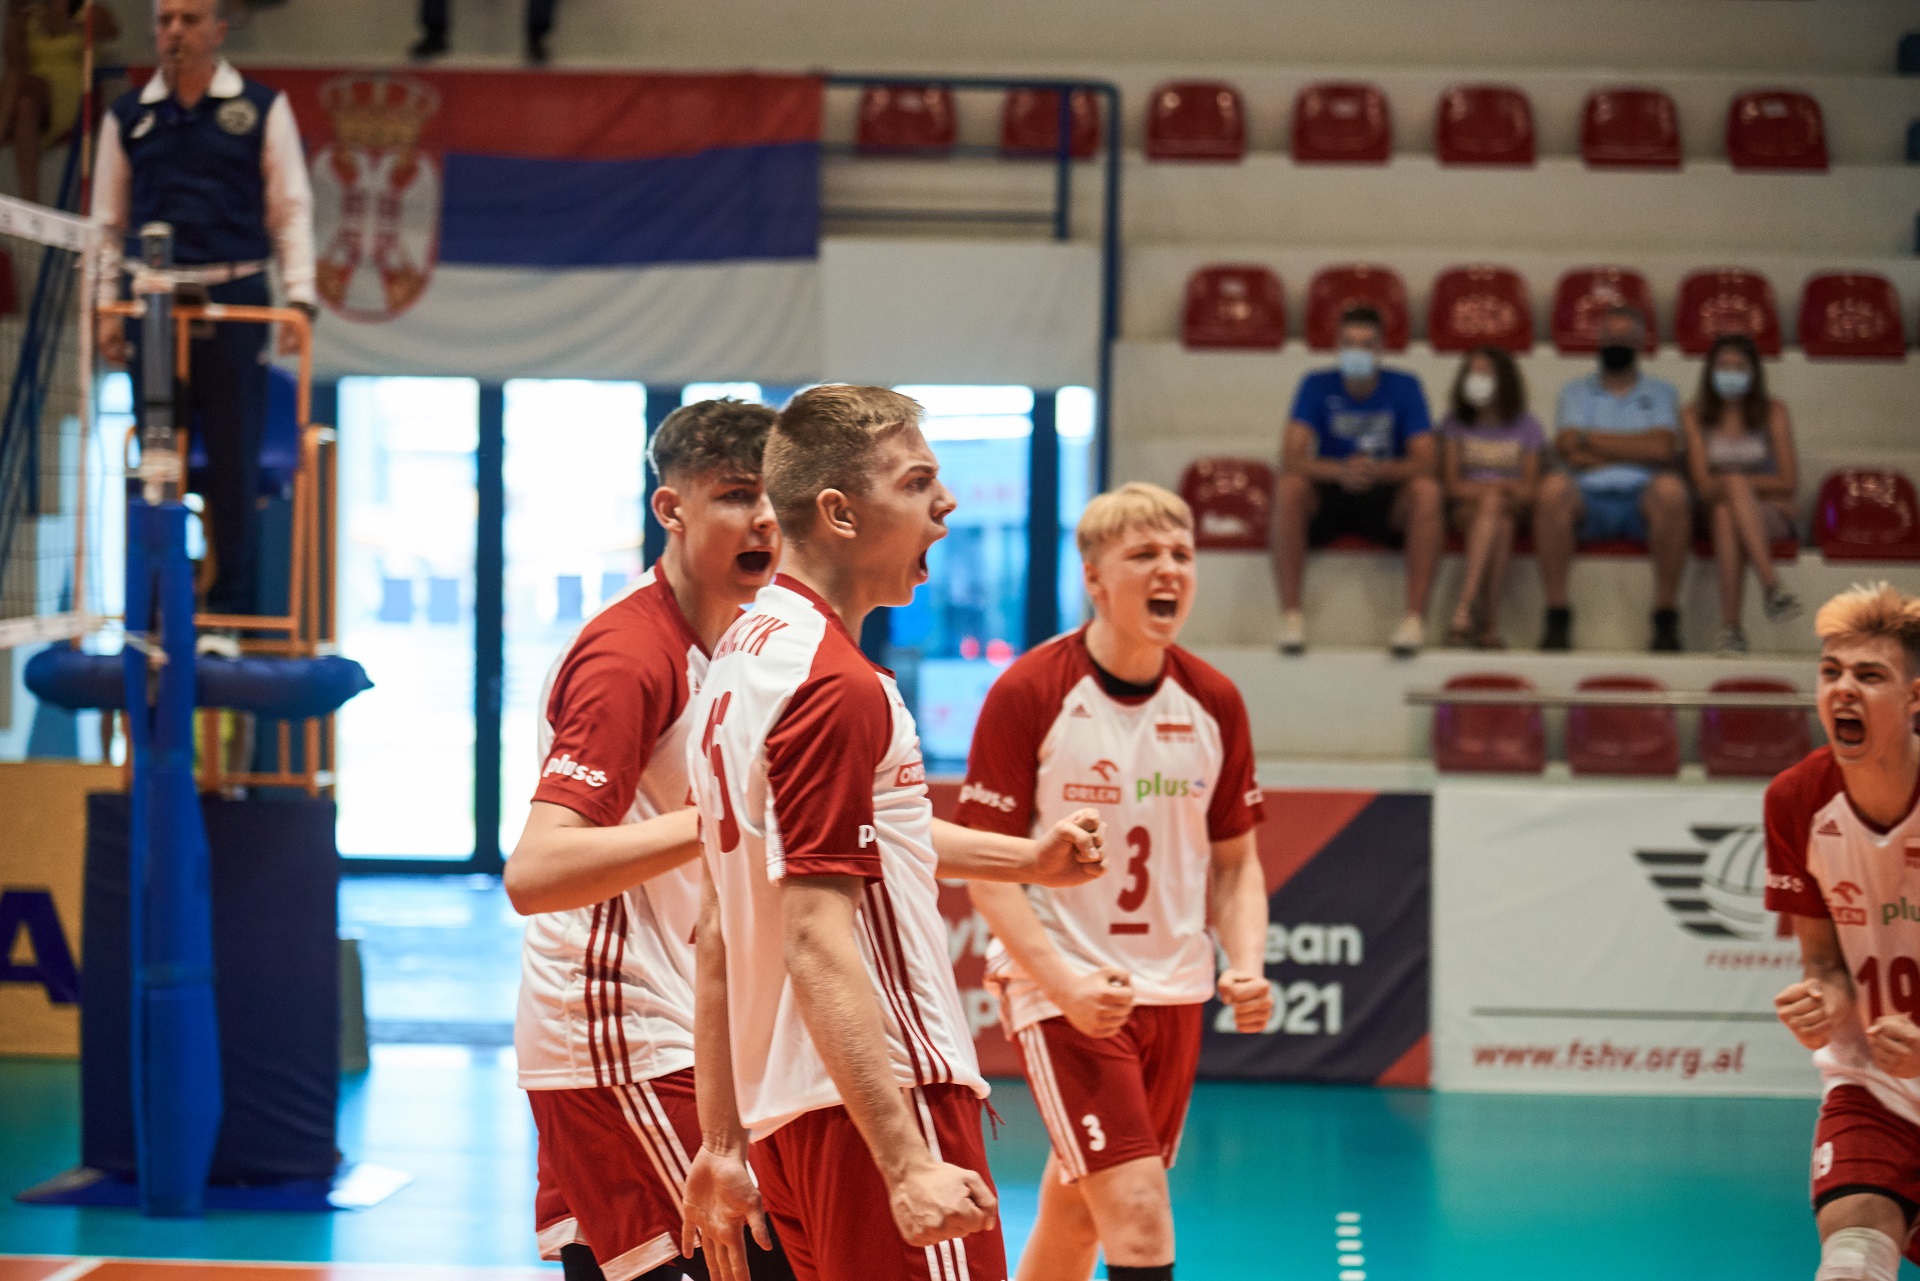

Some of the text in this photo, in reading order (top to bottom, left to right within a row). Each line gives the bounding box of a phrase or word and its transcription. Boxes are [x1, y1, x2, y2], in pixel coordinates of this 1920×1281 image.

[541, 753, 589, 781] plus
[959, 781, 1001, 808] plus
[1136, 772, 1189, 803] plus
[1116, 825, 1151, 913] 3
[1081, 1114, 1106, 1151] 3
